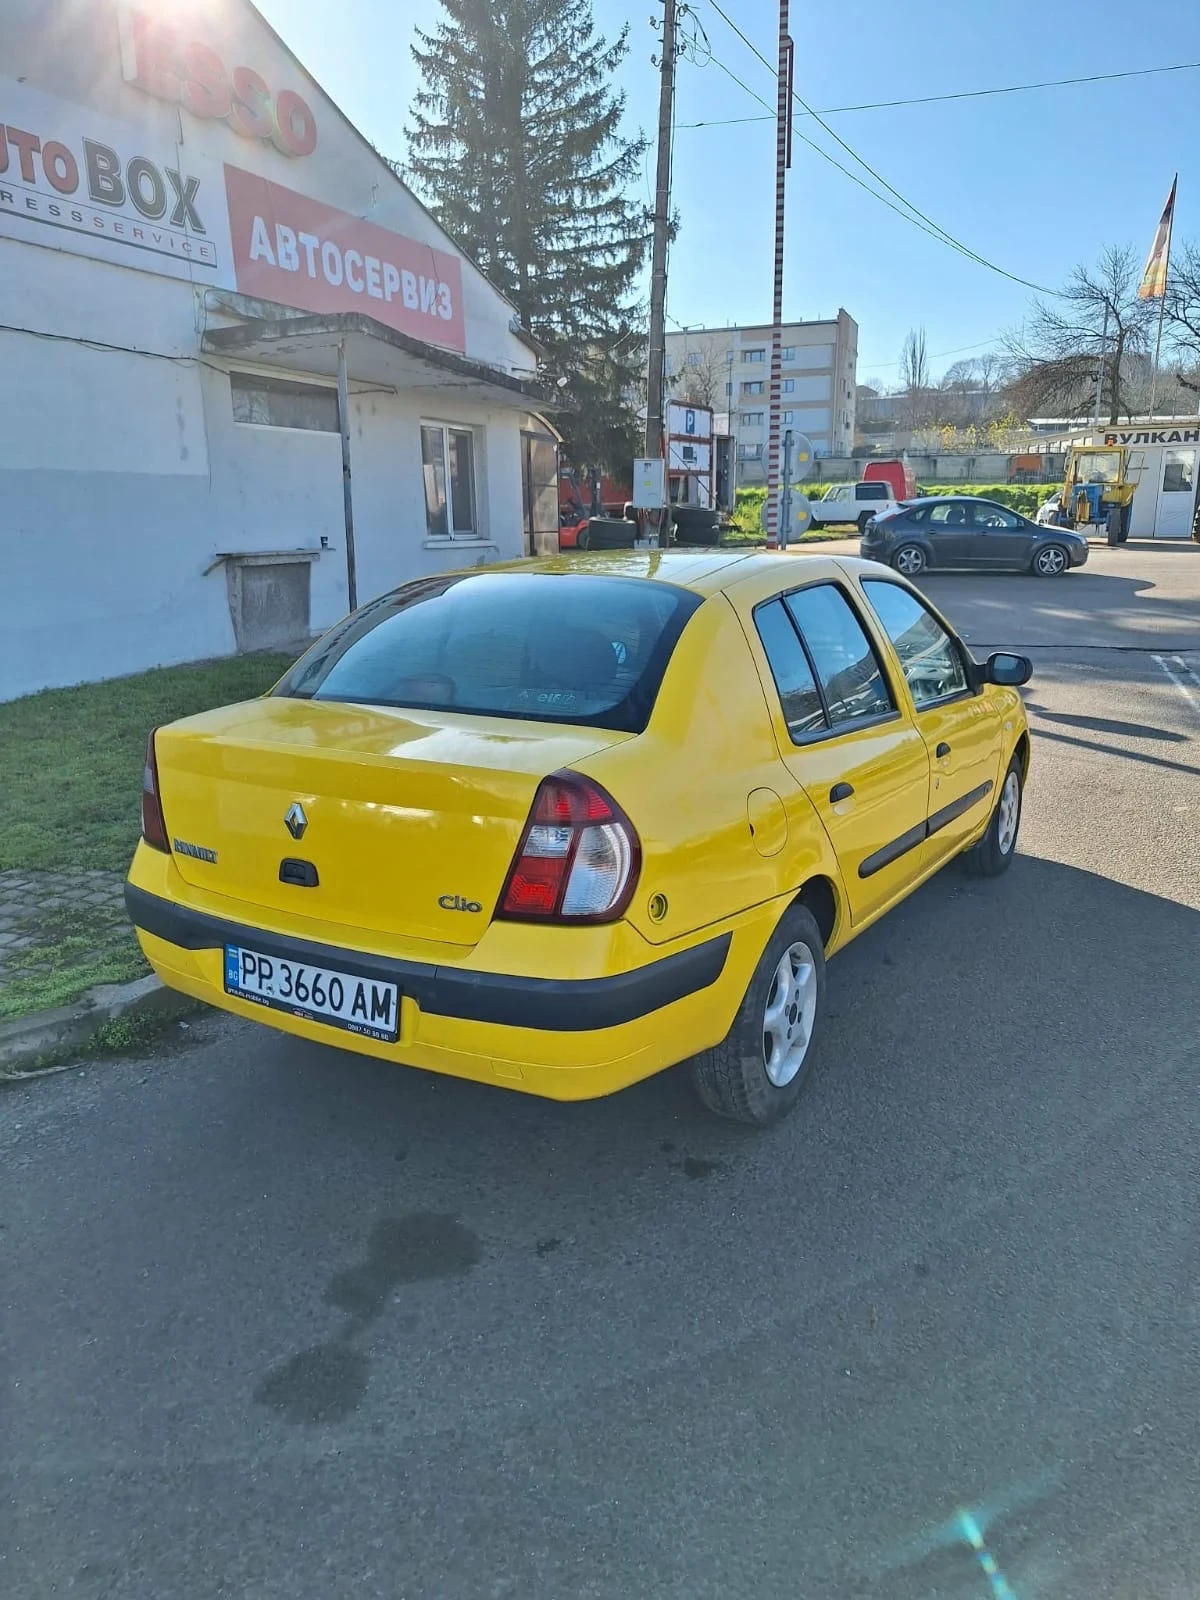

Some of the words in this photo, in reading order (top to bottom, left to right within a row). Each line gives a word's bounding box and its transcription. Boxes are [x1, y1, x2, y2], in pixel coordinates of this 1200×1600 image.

[250, 215, 453, 321] АВТОСЕРВИЗ
[1104, 430, 1200, 445] ВУЛКАН
[174, 838, 217, 864] RENAULT
[438, 895, 483, 913] Clio
[228, 968, 238, 981] BG
[280, 963, 344, 1012] 3660
[351, 982, 392, 1025] AM
